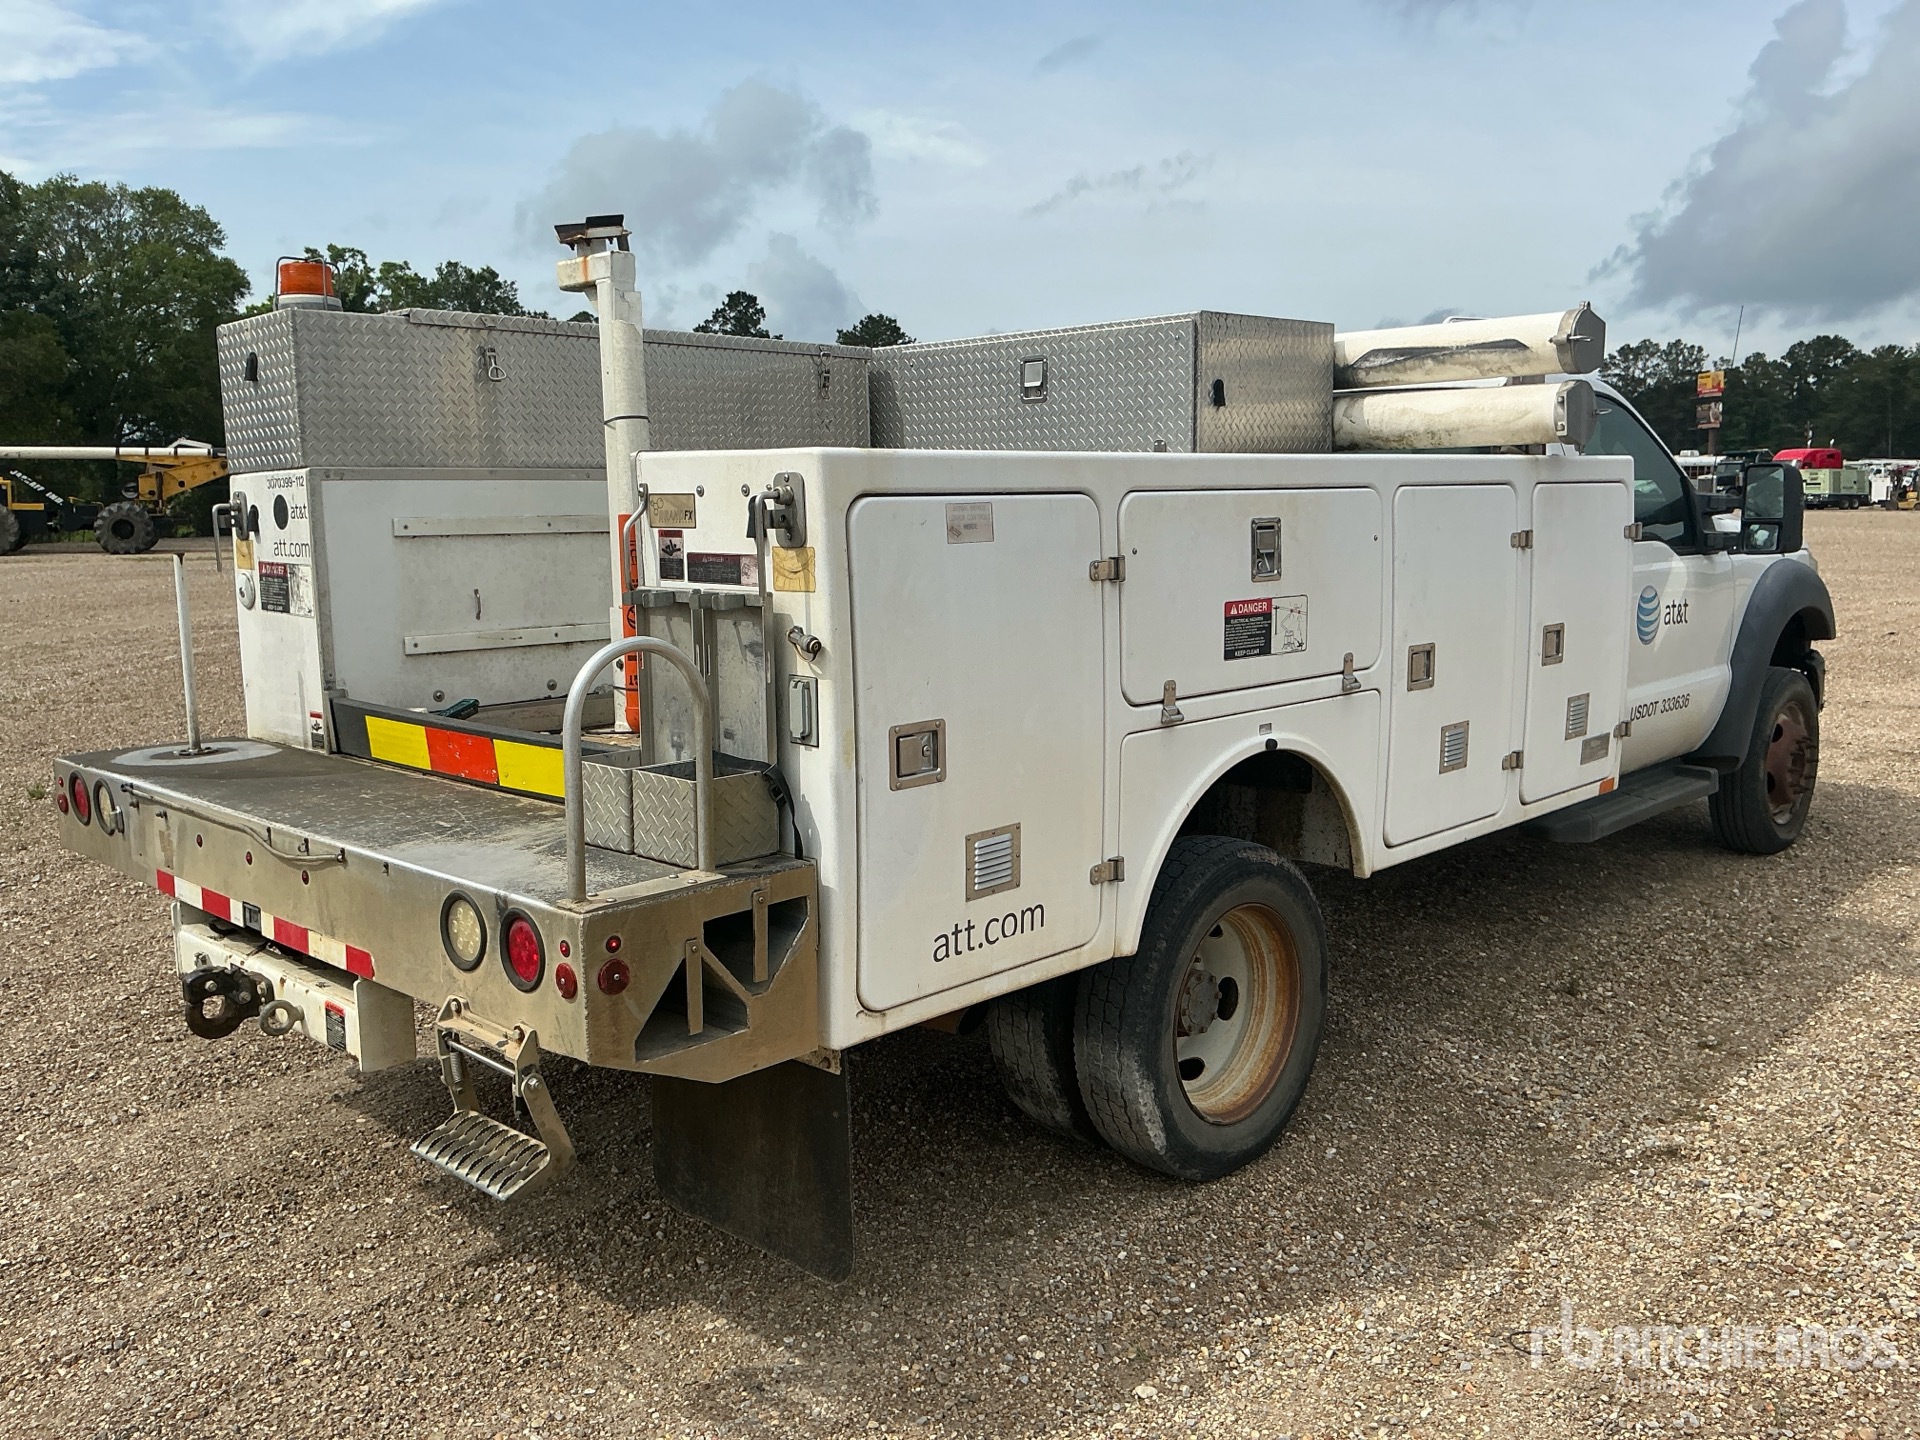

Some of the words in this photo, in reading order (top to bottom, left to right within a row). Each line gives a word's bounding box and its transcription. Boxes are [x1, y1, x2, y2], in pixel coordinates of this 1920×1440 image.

[266, 475, 305, 490] 3070399-112
[290, 504, 308, 519] at&t
[273, 539, 311, 558] att.com
[1238, 601, 1268, 614] DANGER
[1663, 599, 1689, 625] at&t
[1629, 701, 1660, 721] USDOT
[1660, 693, 1690, 714] 333636
[932, 903, 1045, 963] att.com
